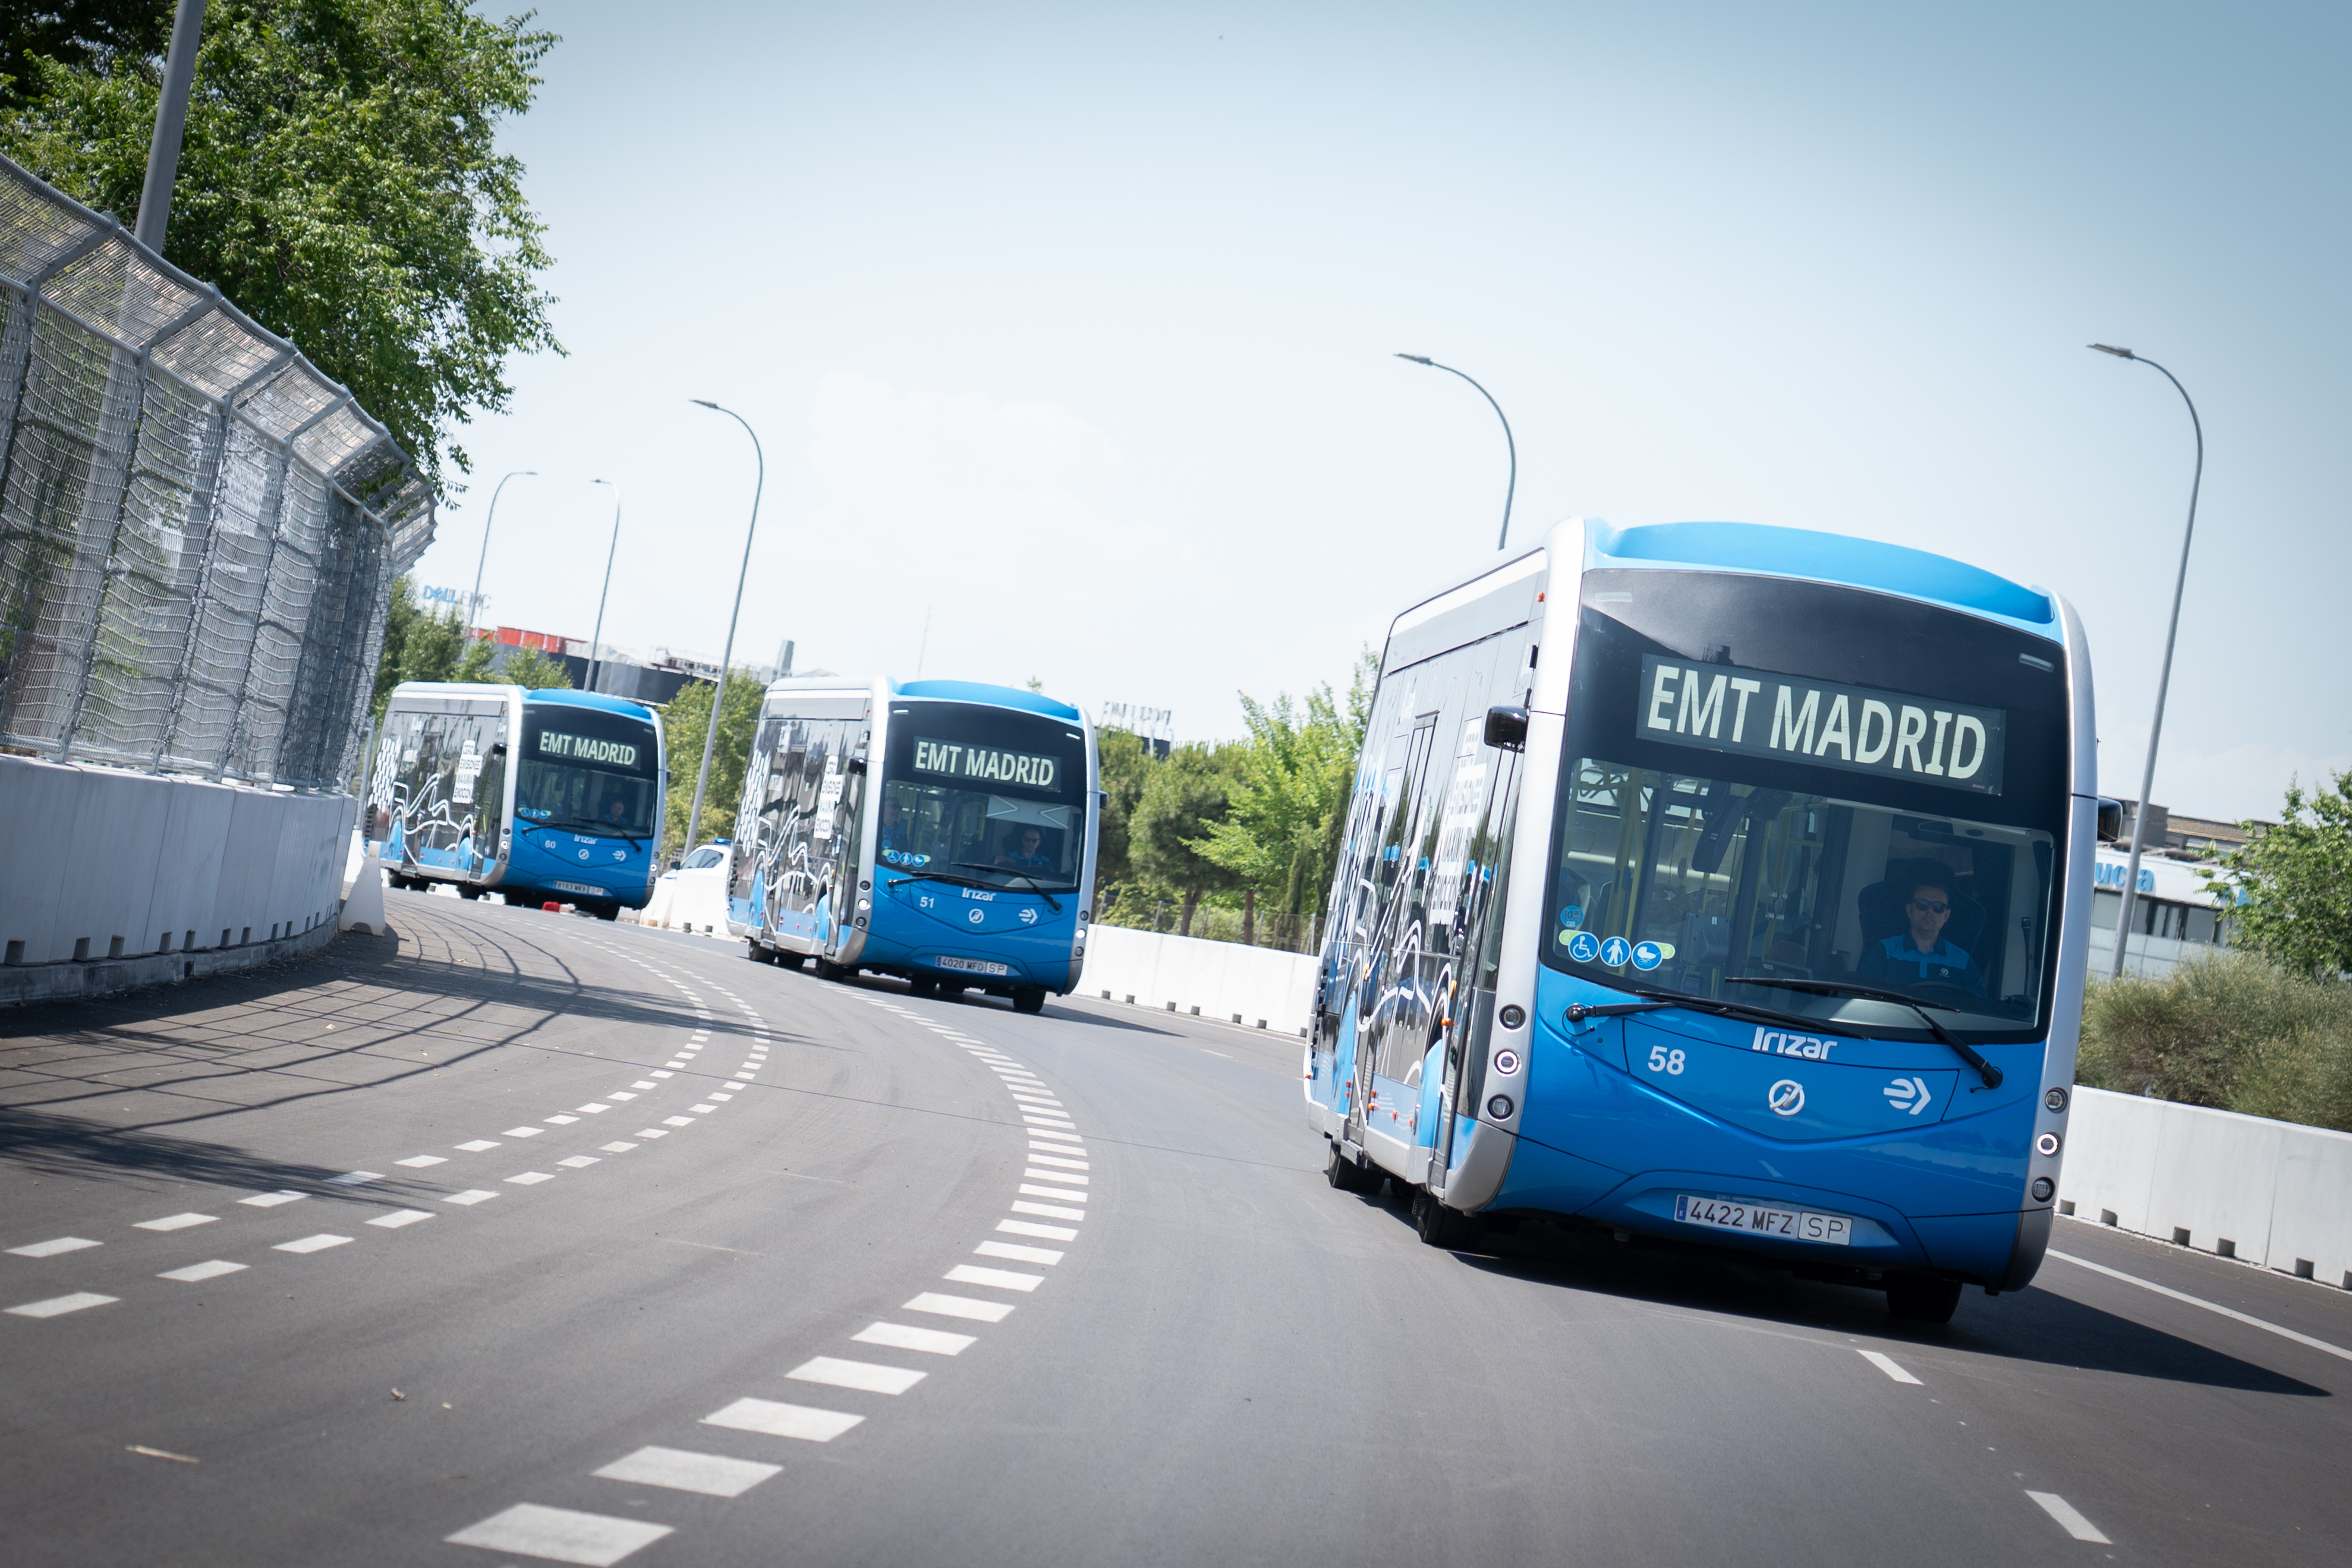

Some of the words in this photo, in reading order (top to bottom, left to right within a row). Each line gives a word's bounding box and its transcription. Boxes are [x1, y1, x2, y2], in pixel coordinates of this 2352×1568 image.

[1647, 664, 1761, 743] EMT
[1769, 684, 1986, 779] MADRID
[540, 731, 572, 755] EMT
[574, 736, 635, 766] MADRID
[915, 741, 962, 773] EMT
[965, 748, 1054, 786] MADRID
[545, 840, 556, 849] 60
[920, 896, 934, 908] 51
[962, 887, 997, 902] Irizar
[1563, 931, 1570, 941] 2
[1664, 946, 1671, 955] 2
[942, 958, 964, 969] 4020
[966, 961, 984, 971] MFD
[988, 964, 1005, 974] SP
[1752, 1027, 1838, 1060] Irizar
[1648, 1045, 1686, 1075] 58
[1690, 1201, 1745, 1227] 4422
[1752, 1210, 1793, 1235] MFZ
[1808, 1217, 1843, 1239] SP
